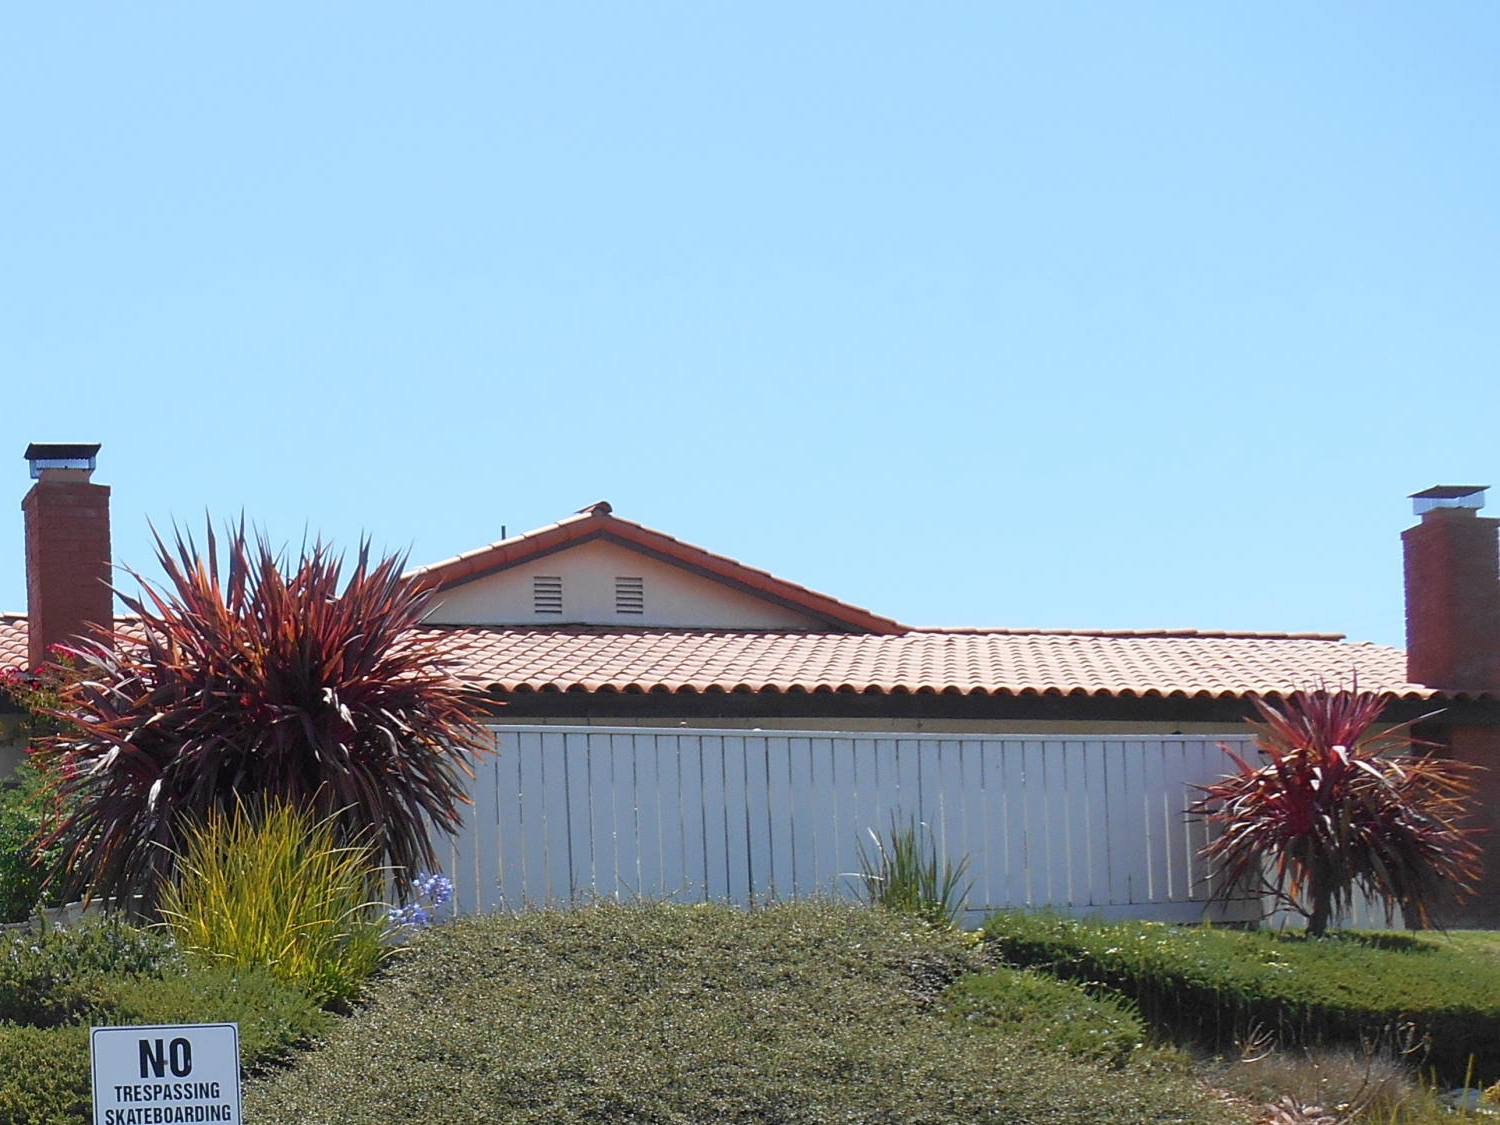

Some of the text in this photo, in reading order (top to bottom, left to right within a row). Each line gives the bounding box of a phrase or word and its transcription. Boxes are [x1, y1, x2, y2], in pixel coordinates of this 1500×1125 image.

[138, 1037, 192, 1078] NO
[114, 1082, 220, 1102] TRESPASSING
[105, 1105, 231, 1125] SKATEBOARDING
